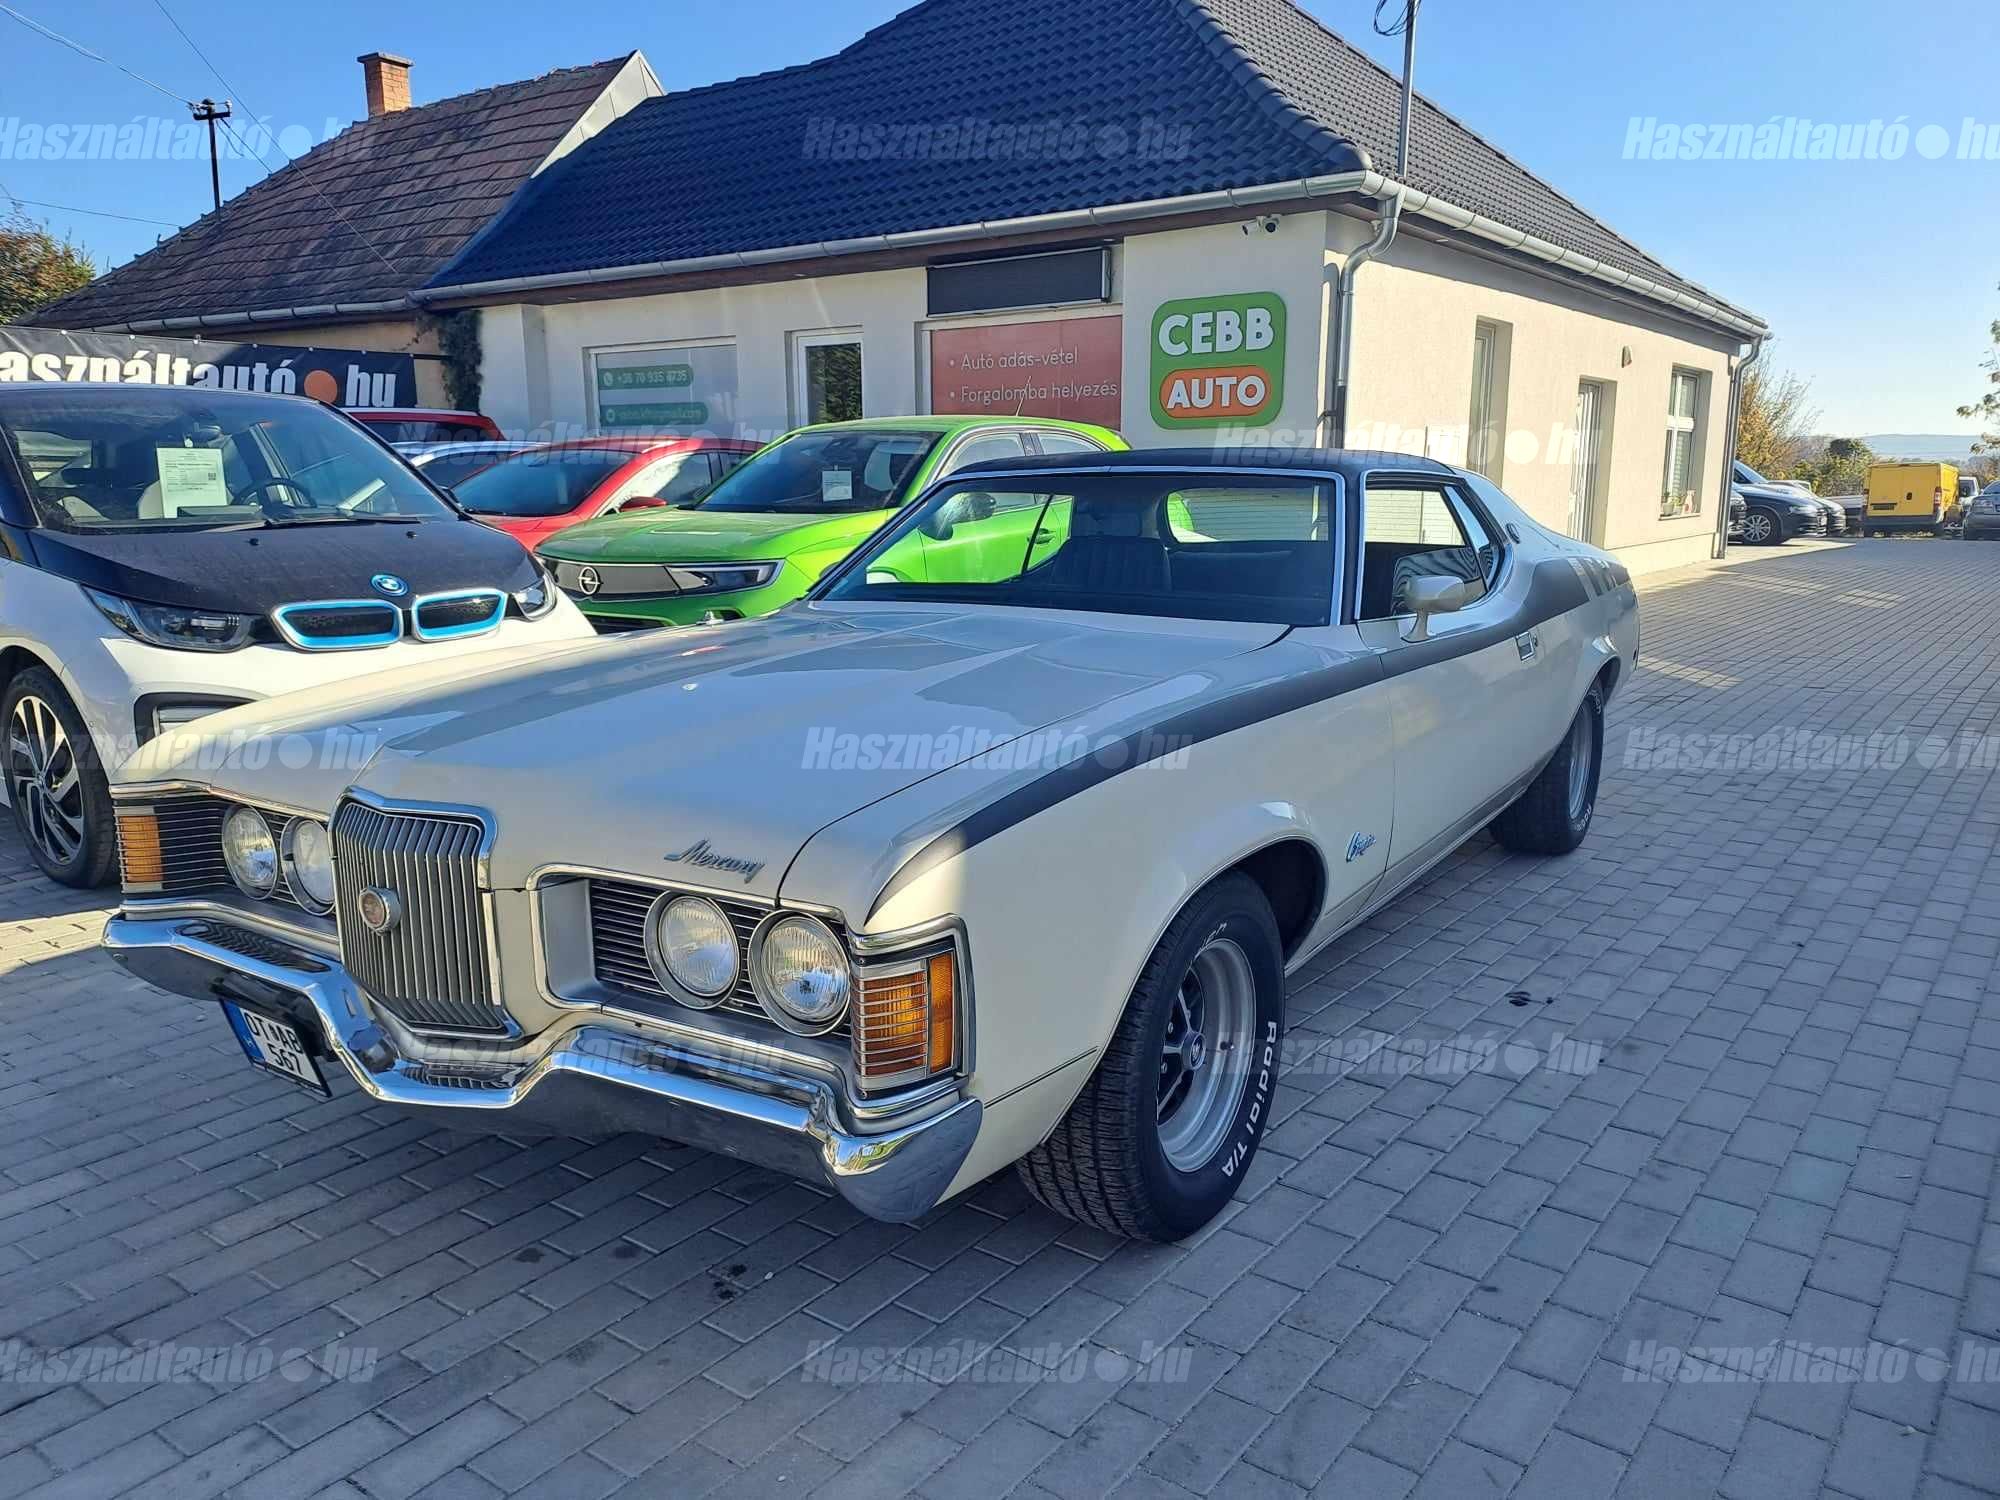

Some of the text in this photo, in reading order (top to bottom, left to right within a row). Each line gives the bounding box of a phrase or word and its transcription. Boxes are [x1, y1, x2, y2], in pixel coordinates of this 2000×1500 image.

[1159, 307, 1274, 356] CEBB
[961, 345, 1079, 370] Autó adás-vétel
[345, 365, 396, 407] hu
[961, 379, 1119, 405] Forgalomba helyezés
[1167, 375, 1266, 408] AUTO
[664, 839, 766, 884] Mercury
[266, 1043, 304, 1076] 567
[1221, 1020, 1278, 1178] Radial T/A
